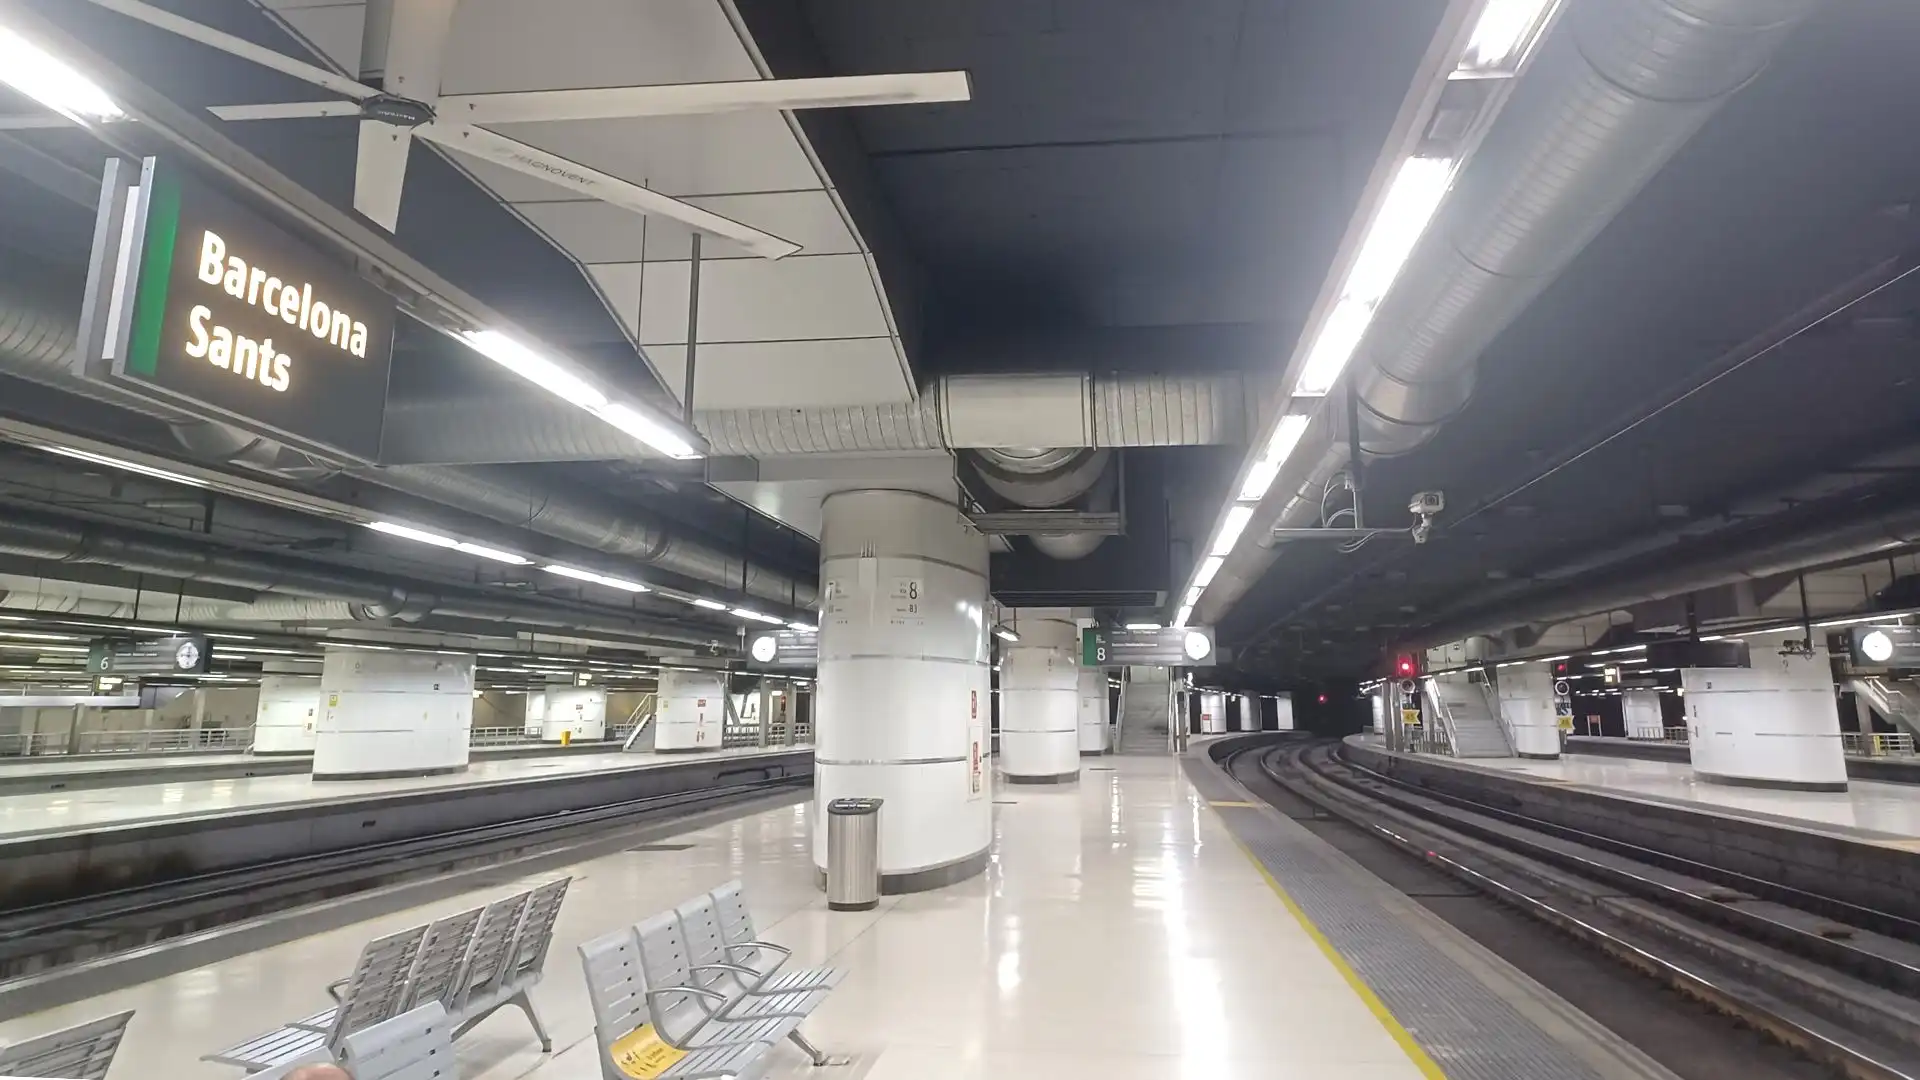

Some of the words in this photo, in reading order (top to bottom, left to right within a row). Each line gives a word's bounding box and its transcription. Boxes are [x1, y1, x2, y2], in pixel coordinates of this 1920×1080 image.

[198, 229, 368, 359] Barcelona
[185, 304, 292, 392] Sants
[909, 581, 917, 600] 8
[100, 656, 109, 670] 6
[1097, 647, 1106, 661] 8
